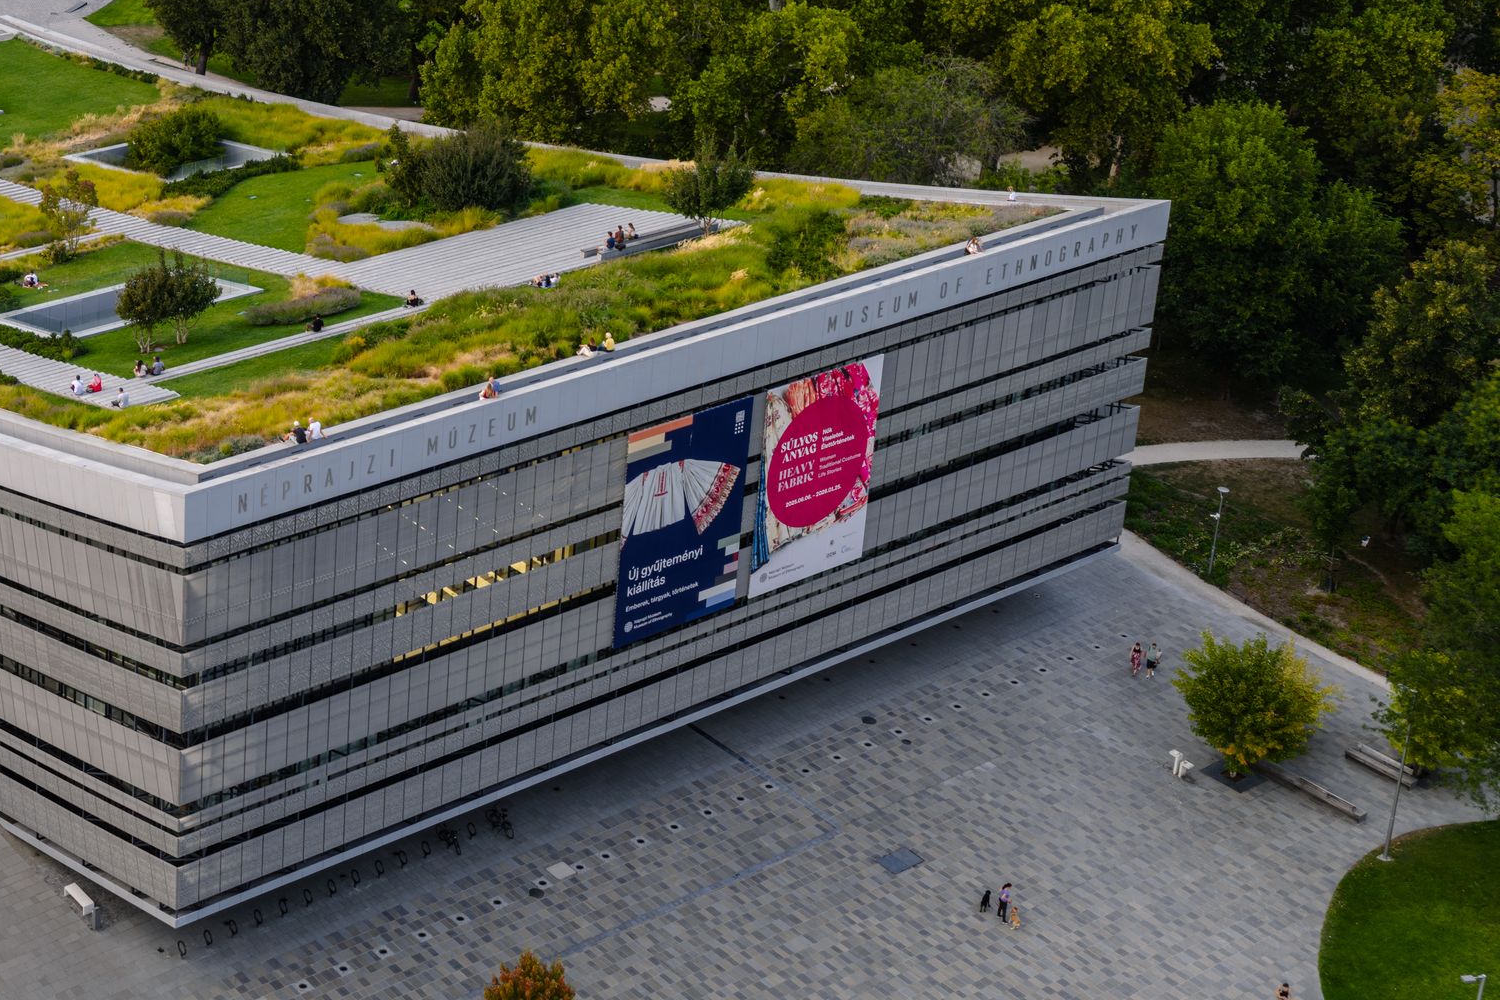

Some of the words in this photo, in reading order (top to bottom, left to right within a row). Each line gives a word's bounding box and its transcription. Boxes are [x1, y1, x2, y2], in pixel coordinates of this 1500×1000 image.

[827, 290, 918, 334] MUSEUM
[940, 277, 963, 299] OF
[986, 223, 1138, 285] ETHNOGRAPHY
[780, 431, 818, 453] SÚLYOS
[238, 448, 395, 514] NÉPRAJZI
[427, 405, 537, 457] MÚZEUM
[782, 443, 817, 464] ANYAG
[778, 460, 816, 481] HEAVY
[778, 471, 814, 493] FABRIC
[628, 565, 639, 581] Új
[641, 544, 704, 579] gyűjteményi
[626, 575, 666, 597] kiállítás
